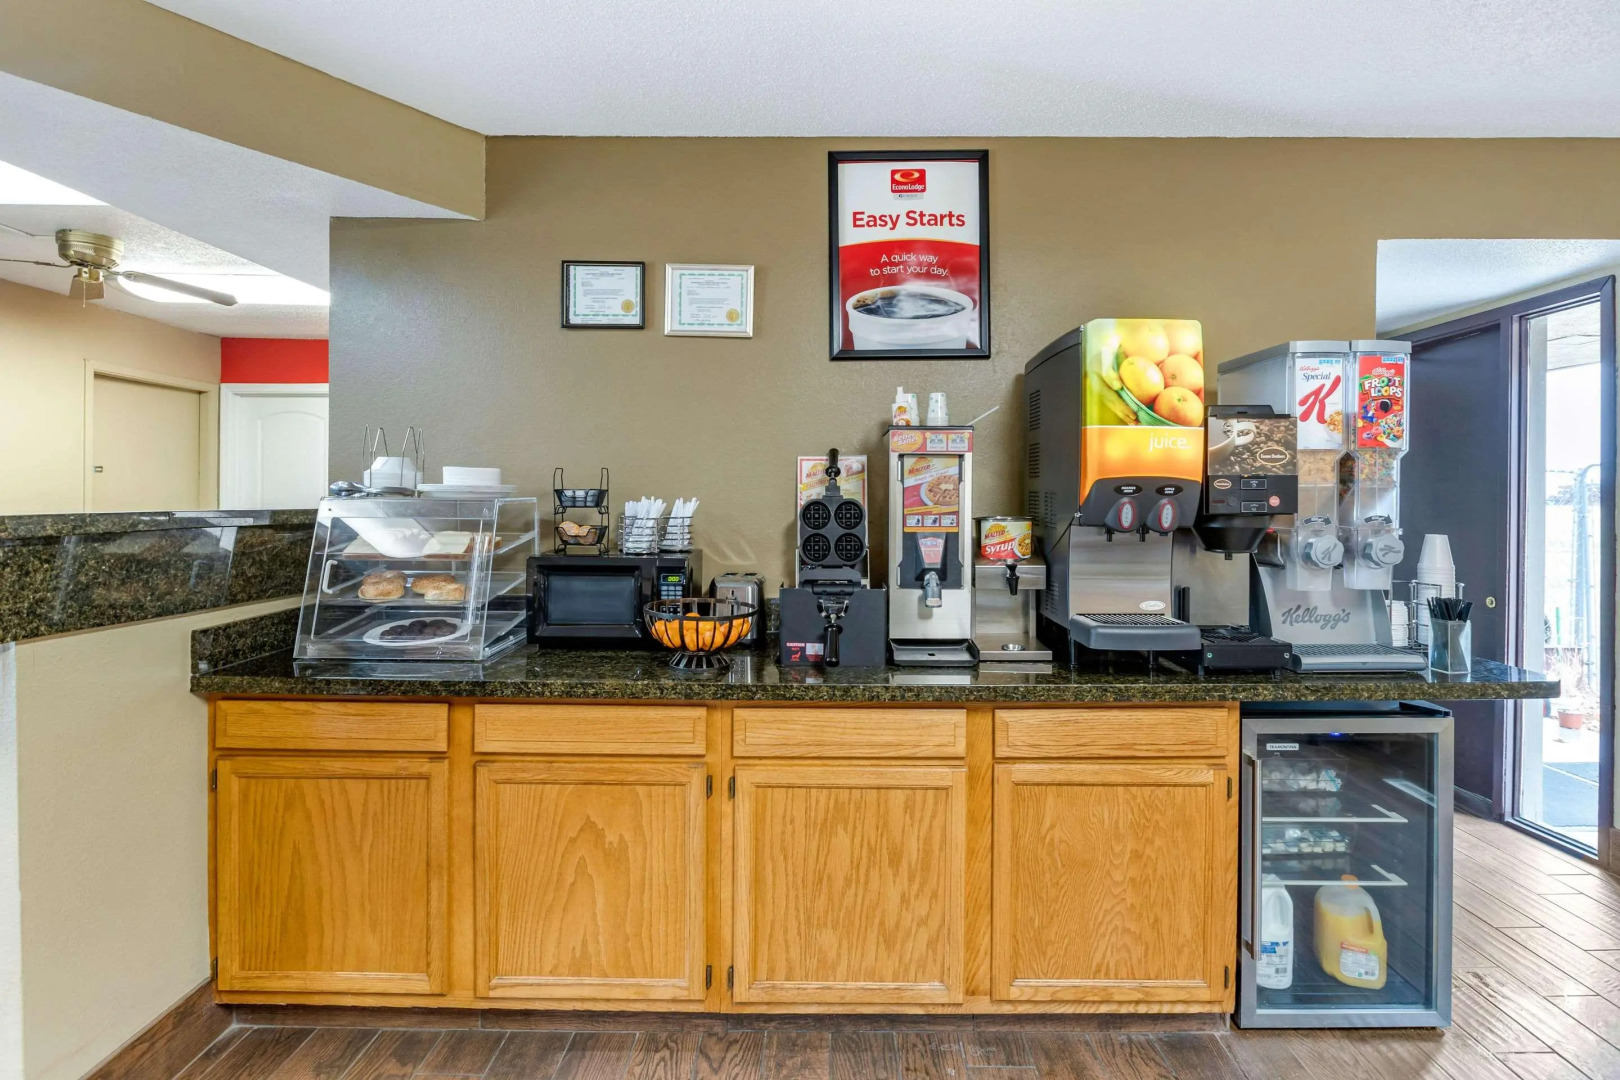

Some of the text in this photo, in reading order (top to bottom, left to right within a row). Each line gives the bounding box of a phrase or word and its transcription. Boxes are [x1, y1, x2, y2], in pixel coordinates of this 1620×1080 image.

[892, 183, 925, 191] EconoLodge
[852, 210, 966, 230] Easy Starts
[881, 252, 938, 264] A quick way
[870, 265, 949, 277] to start your day.
[1302, 372, 1331, 382] Special
[1364, 377, 1401, 390] FROOT
[1371, 386, 1402, 397] LOOPS
[1298, 374, 1342, 424] K
[1149, 433, 1188, 452] juice
[985, 541, 1015, 555] Syrup
[1281, 605, 1351, 630] Kellogg's
